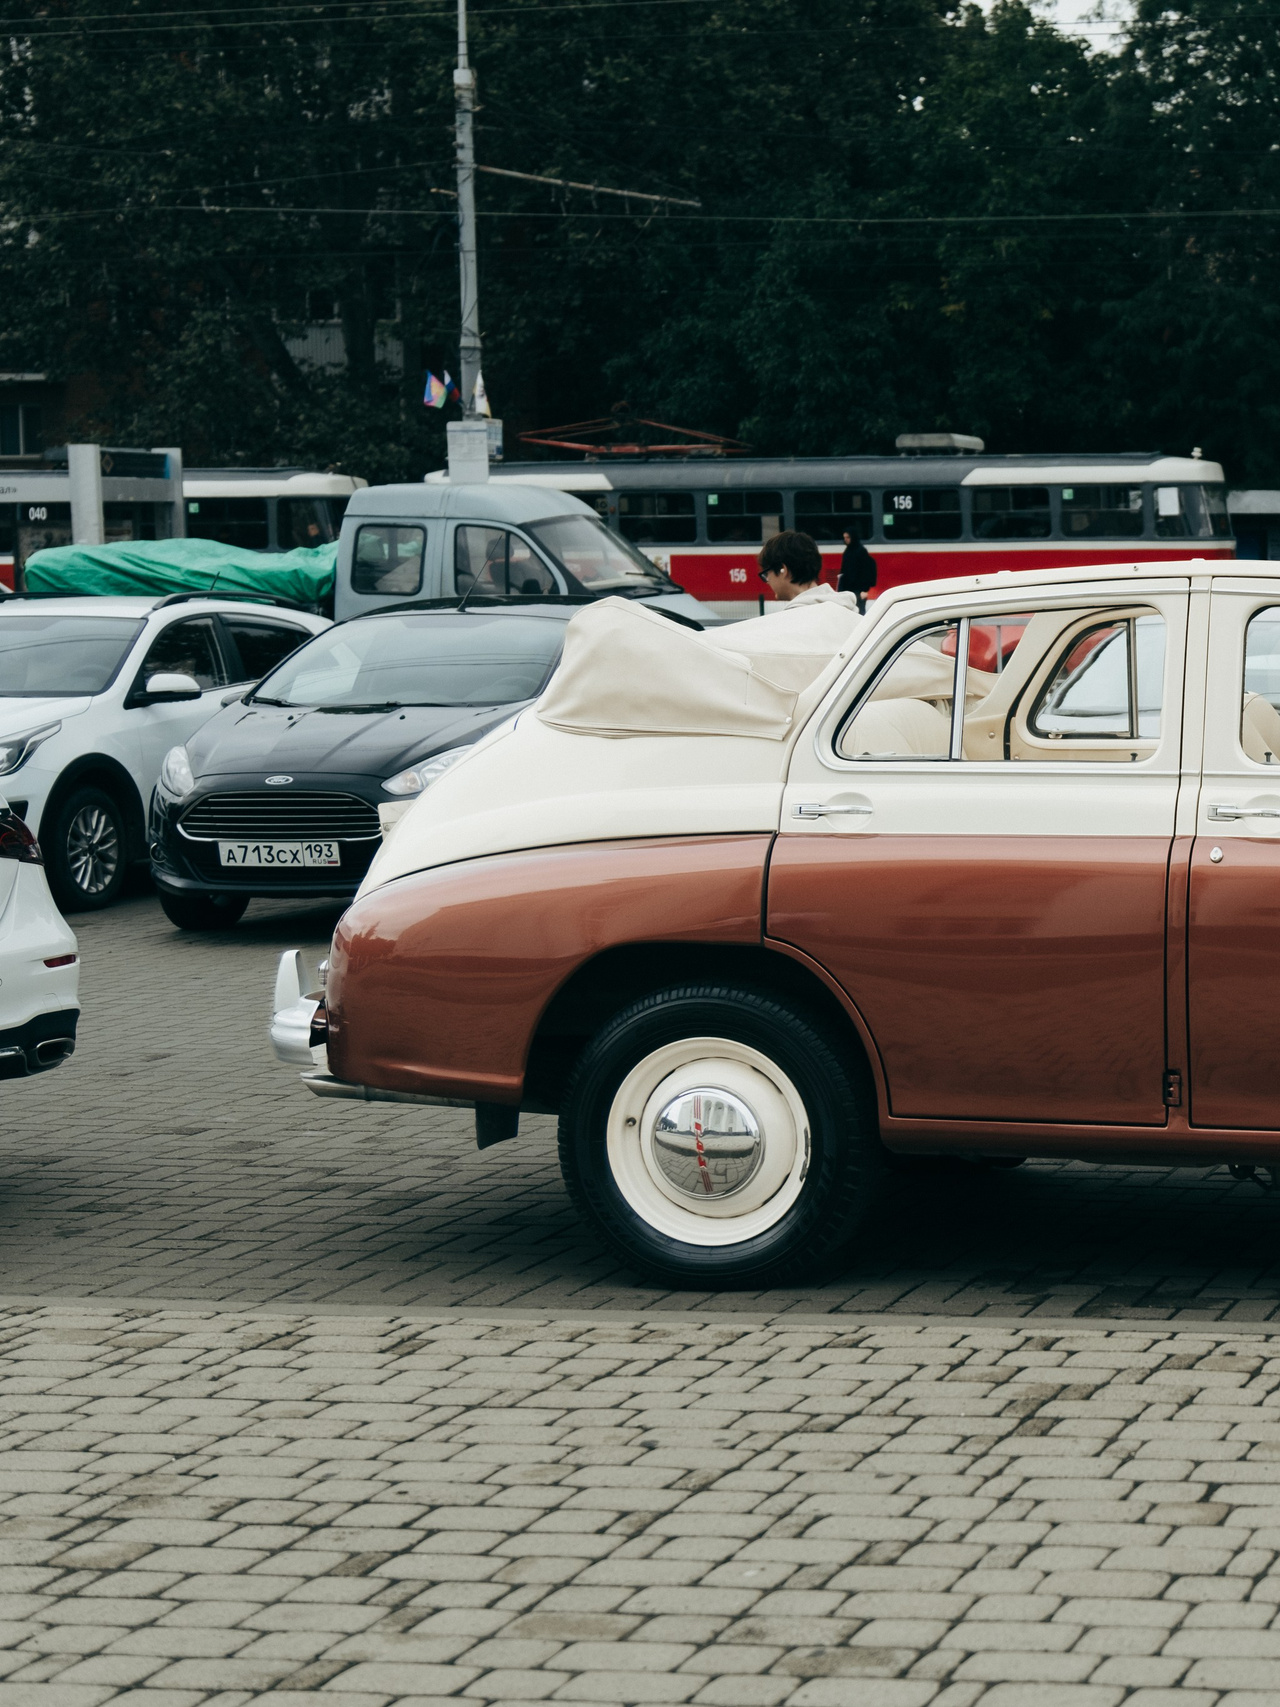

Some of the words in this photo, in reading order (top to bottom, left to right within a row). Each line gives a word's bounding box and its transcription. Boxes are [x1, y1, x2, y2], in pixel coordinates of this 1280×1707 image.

[893, 496, 912, 509] 156
[28, 507, 47, 520] 040
[729, 569, 746, 582] 156
[304, 844, 333, 858] 193
